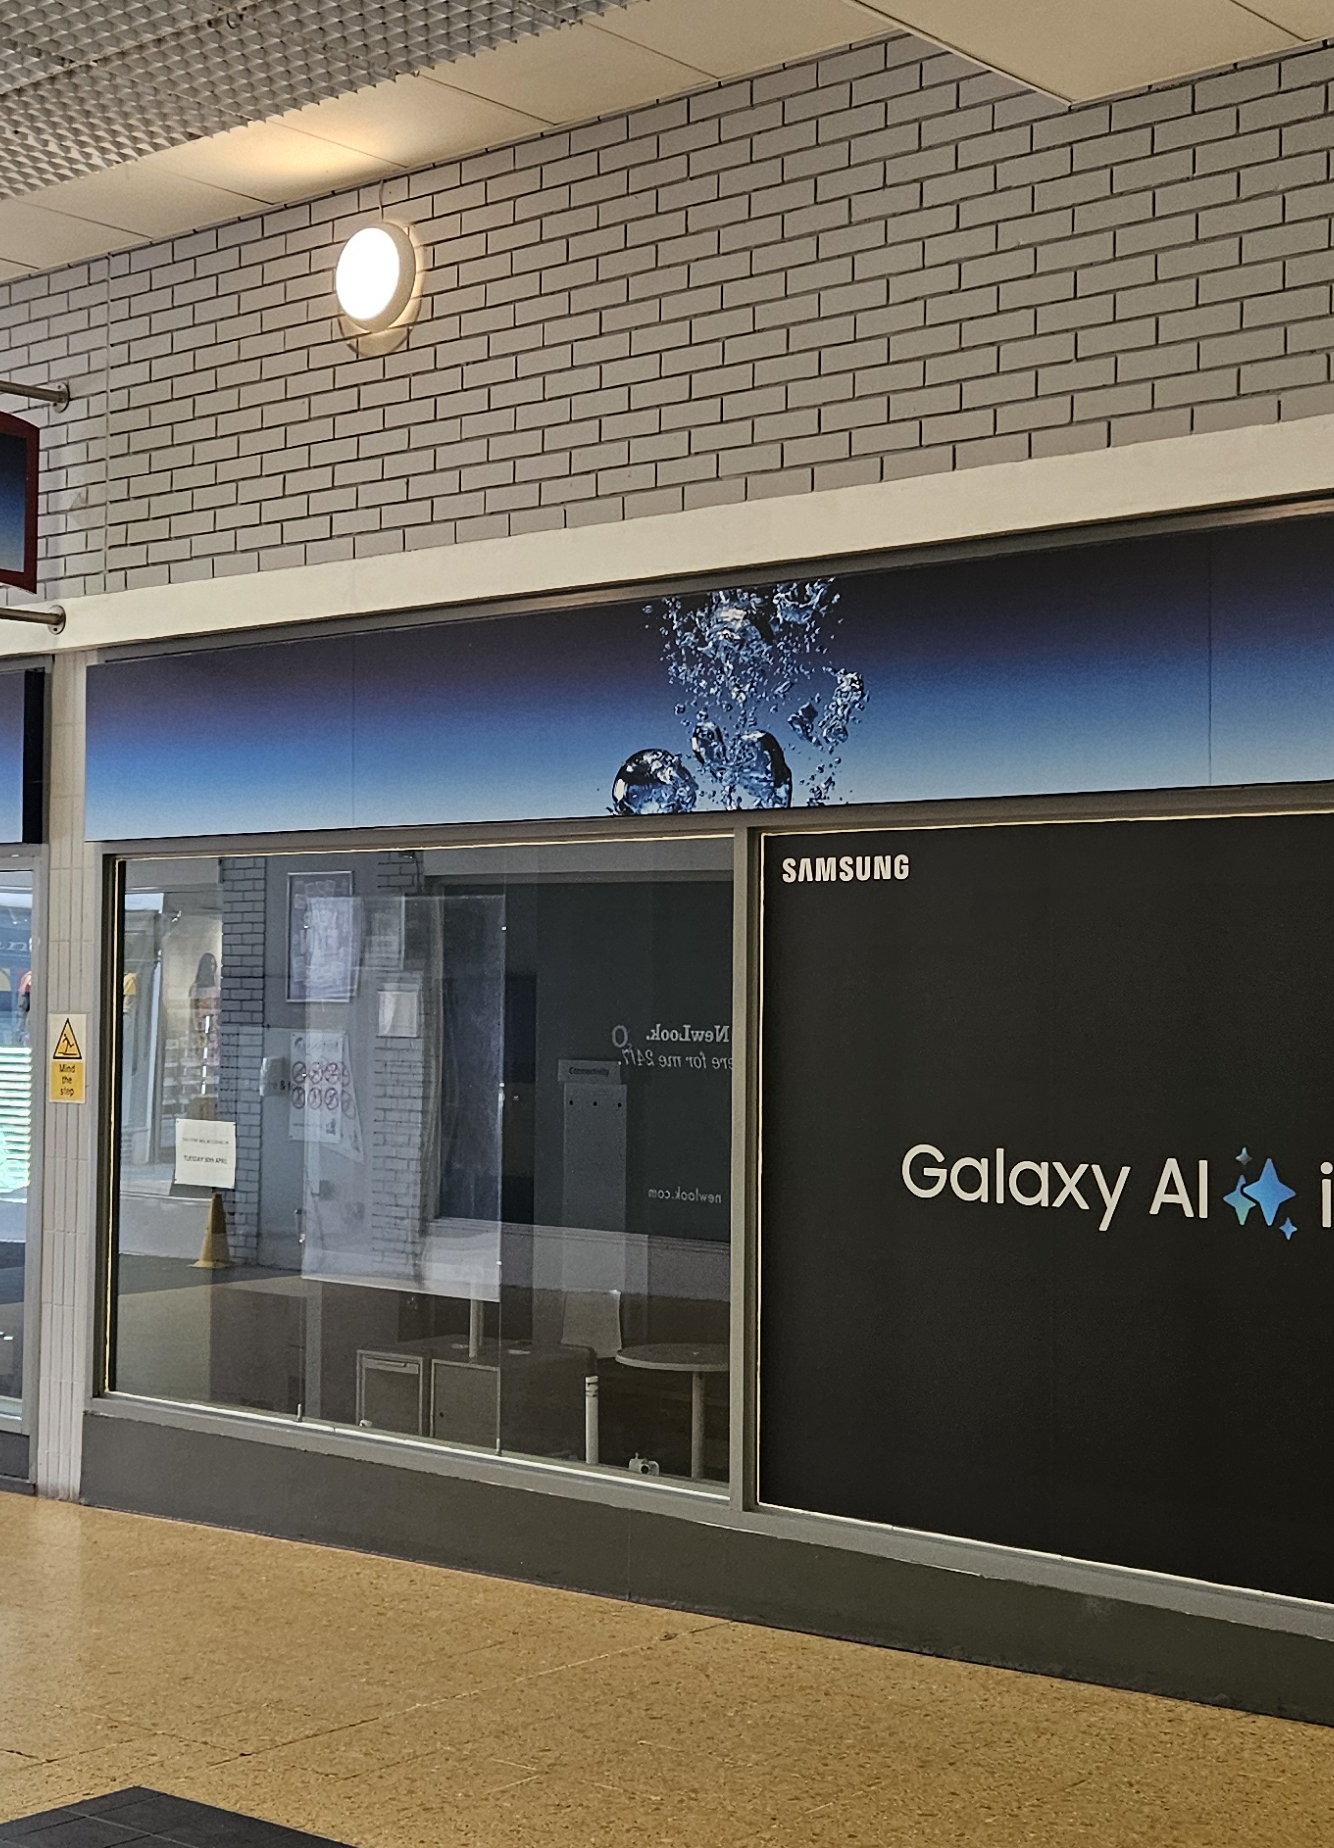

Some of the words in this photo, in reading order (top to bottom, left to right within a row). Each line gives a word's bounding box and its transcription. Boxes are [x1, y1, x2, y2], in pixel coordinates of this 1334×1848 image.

[782, 853, 910, 884] SAMSUNG
[59, 1063, 76, 1074] Mind
[62, 1076, 73, 1085] the
[60, 1087, 75, 1097] step
[901, 1143, 1131, 1232] Galaxy
[1149, 1158, 1209, 1219] AI
